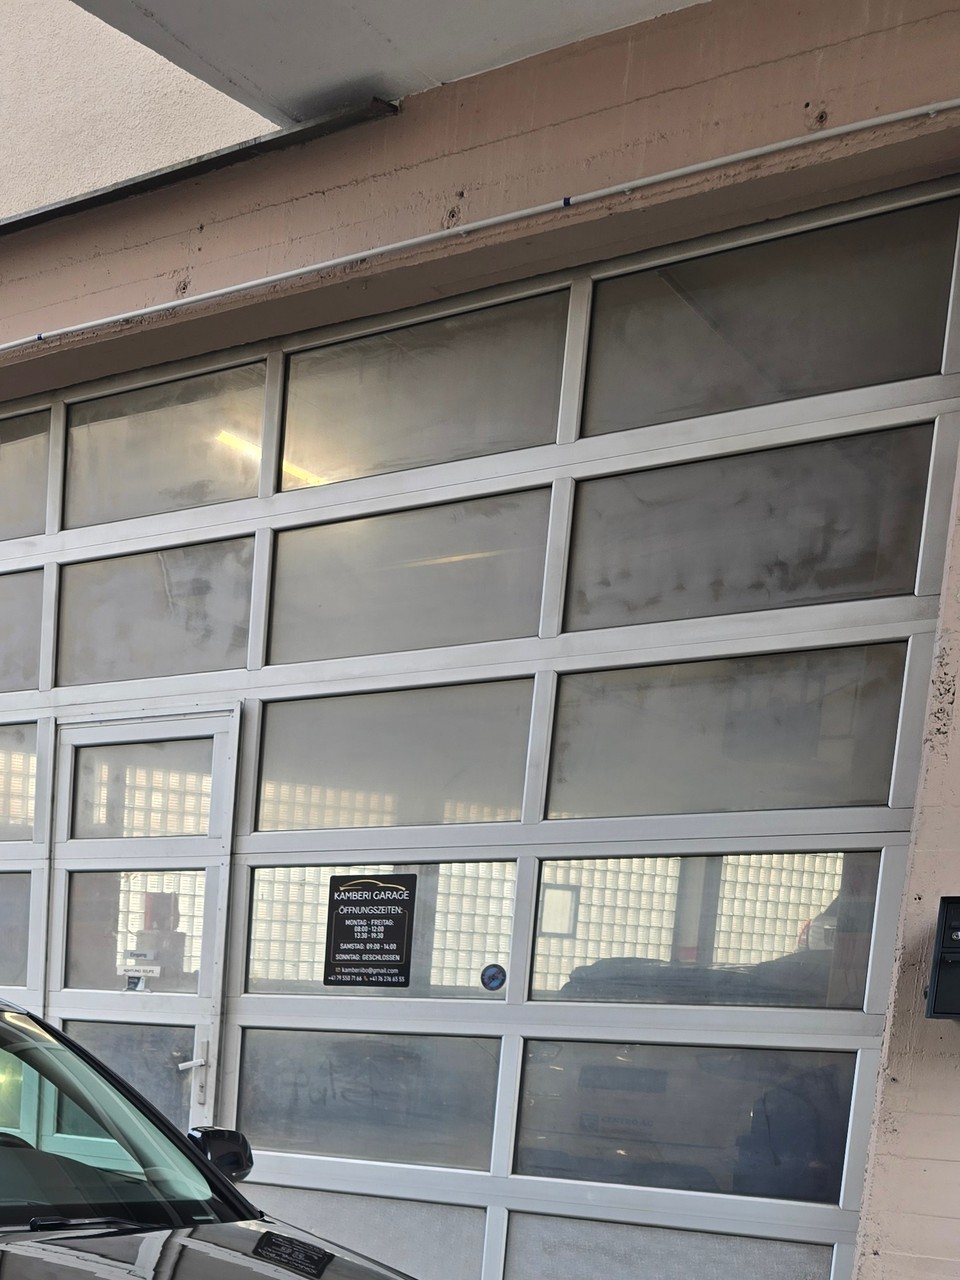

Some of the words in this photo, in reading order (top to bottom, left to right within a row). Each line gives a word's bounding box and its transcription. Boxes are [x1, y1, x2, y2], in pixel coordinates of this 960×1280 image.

[334, 891, 371, 900] KAMBERI
[373, 891, 409, 899] GARAGE
[338, 905, 403, 914] ÖFFNUNGSZEITEN:
